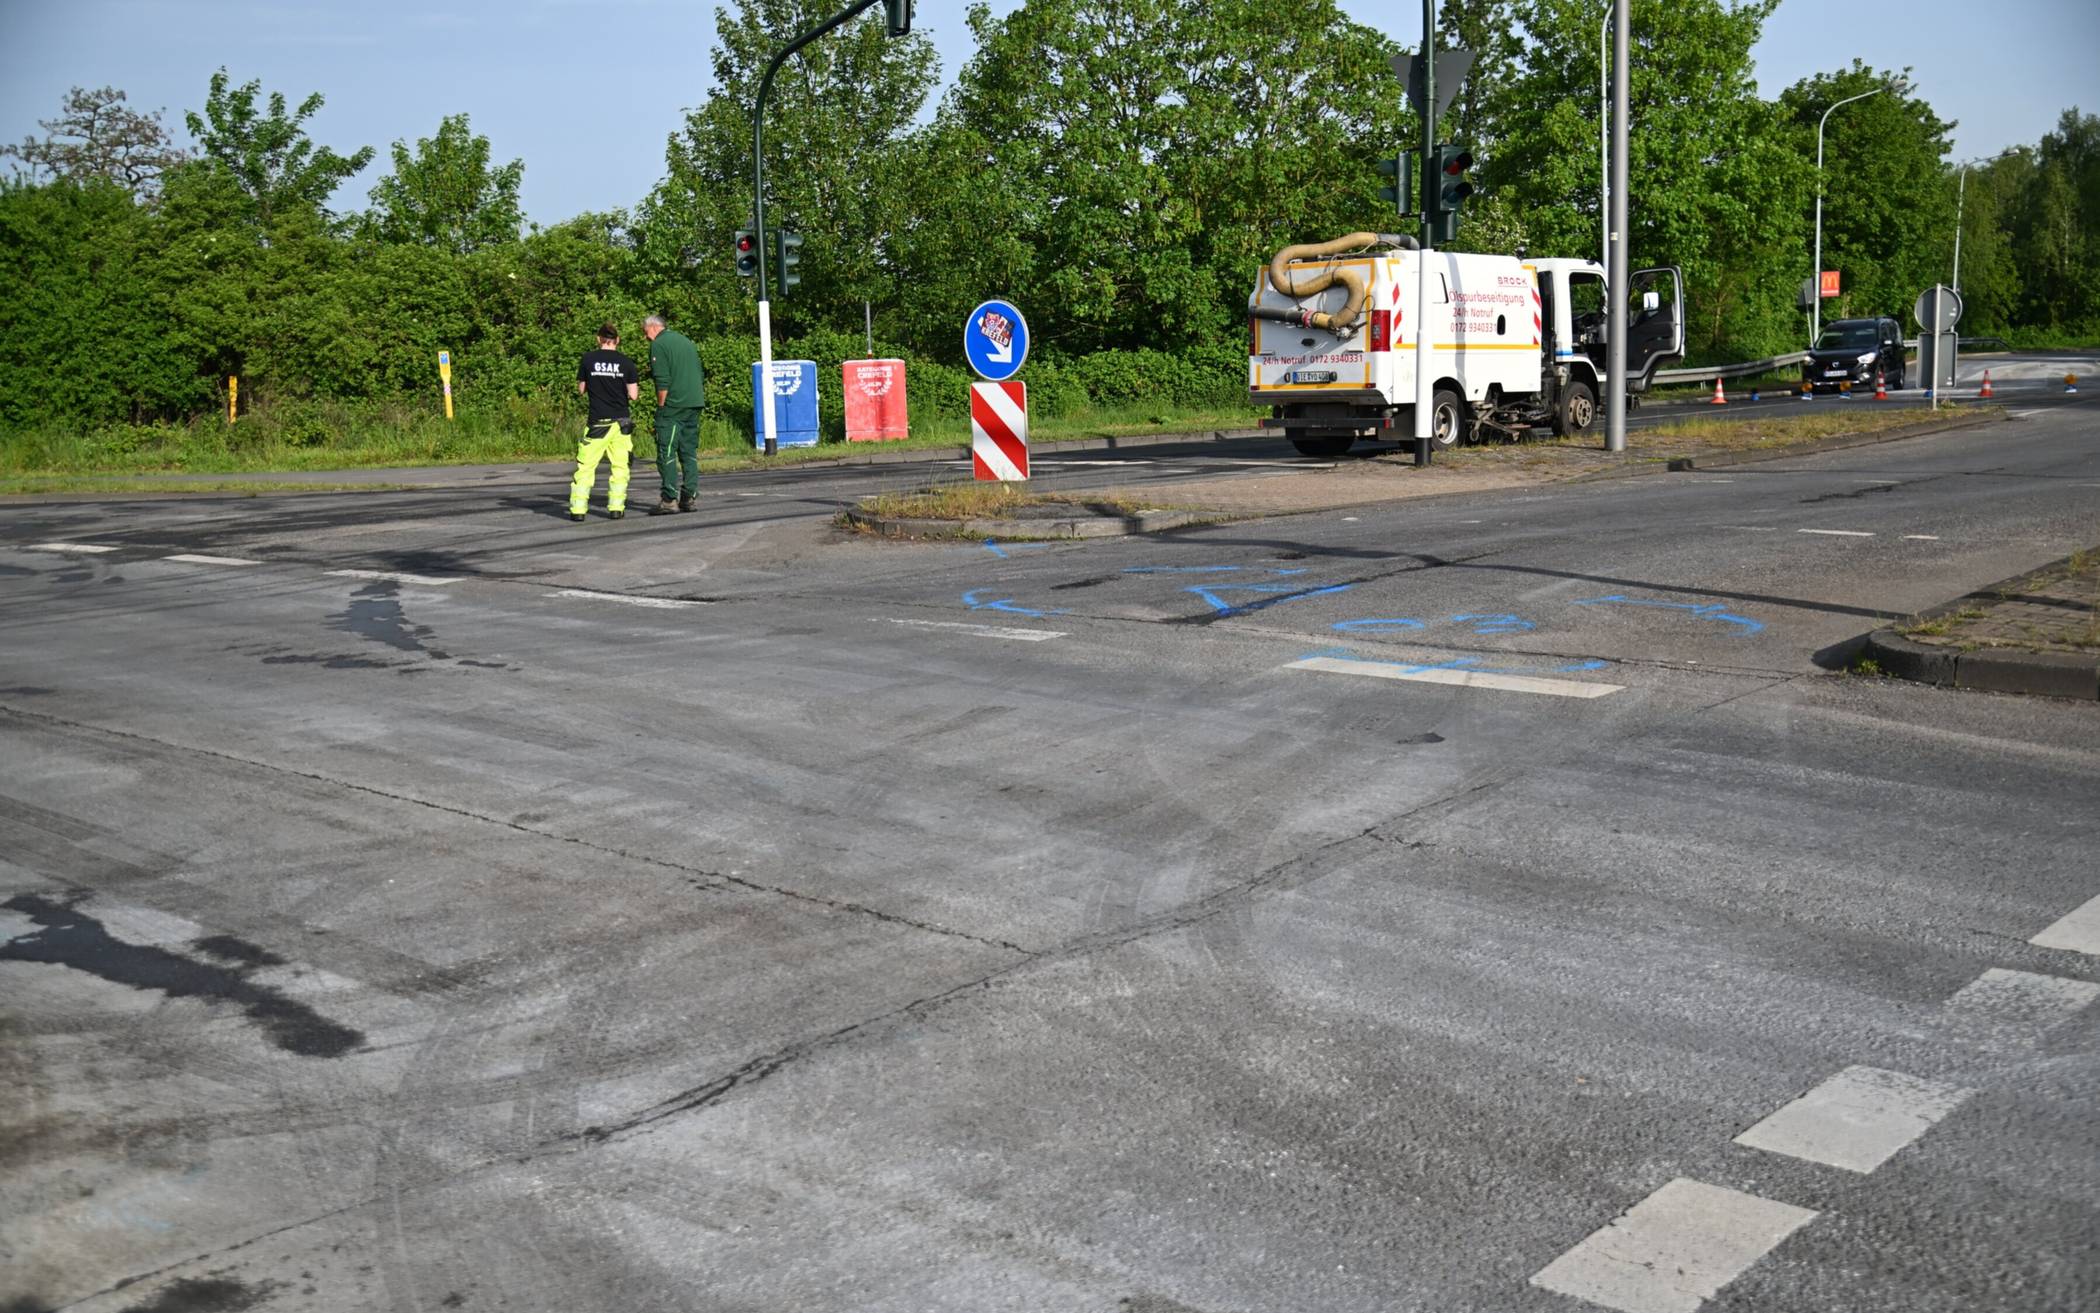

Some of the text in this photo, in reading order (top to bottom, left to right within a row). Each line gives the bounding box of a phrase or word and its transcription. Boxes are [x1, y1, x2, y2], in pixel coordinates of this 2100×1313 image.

[1497, 276, 1528, 285] BROCK
[1449, 289, 1525, 307] Ölspurbeseitigung
[1470, 307, 1494, 318] Notruf
[1450, 322, 1467, 333] 0172
[1263, 354, 1363, 365] 24/h Notruf 0172 9340331
[595, 362, 620, 373] GSAK
